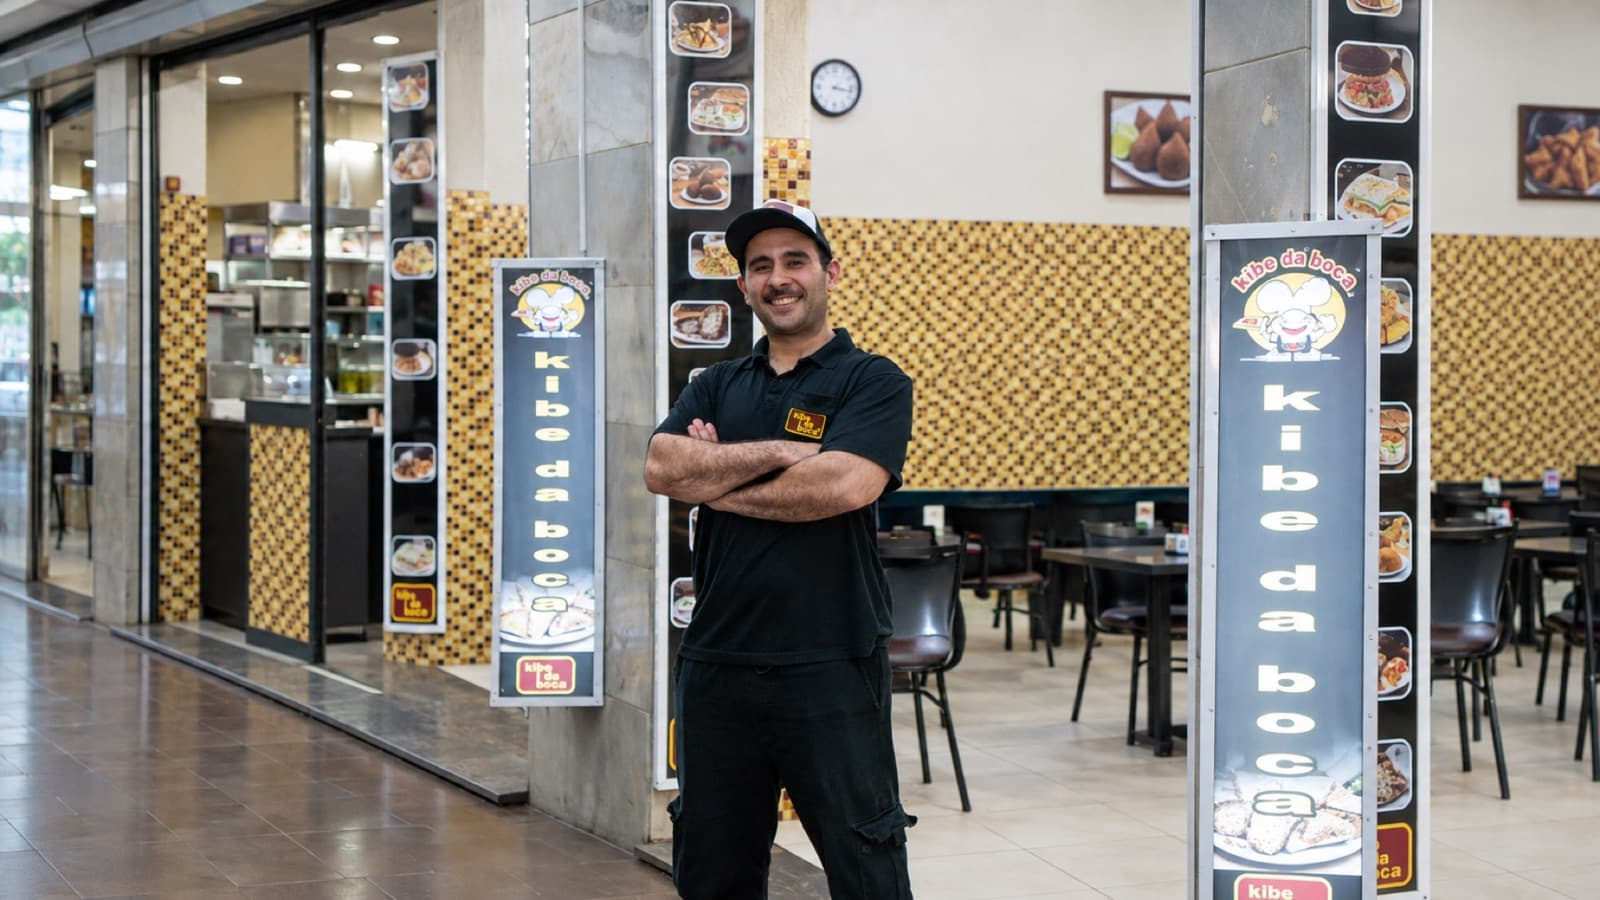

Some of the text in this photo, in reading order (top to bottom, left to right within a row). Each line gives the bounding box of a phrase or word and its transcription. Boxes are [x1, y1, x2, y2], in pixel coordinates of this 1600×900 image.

[1231, 248, 1357, 293] kibe da boca
[532, 351, 570, 612] kibe da boca
[1253, 384, 1320, 817] kibe da boca
[525, 661, 553, 672] kibe
[536, 672, 567, 689] boca
[544, 671, 560, 681] da
[1248, 884, 1294, 900] kibe
